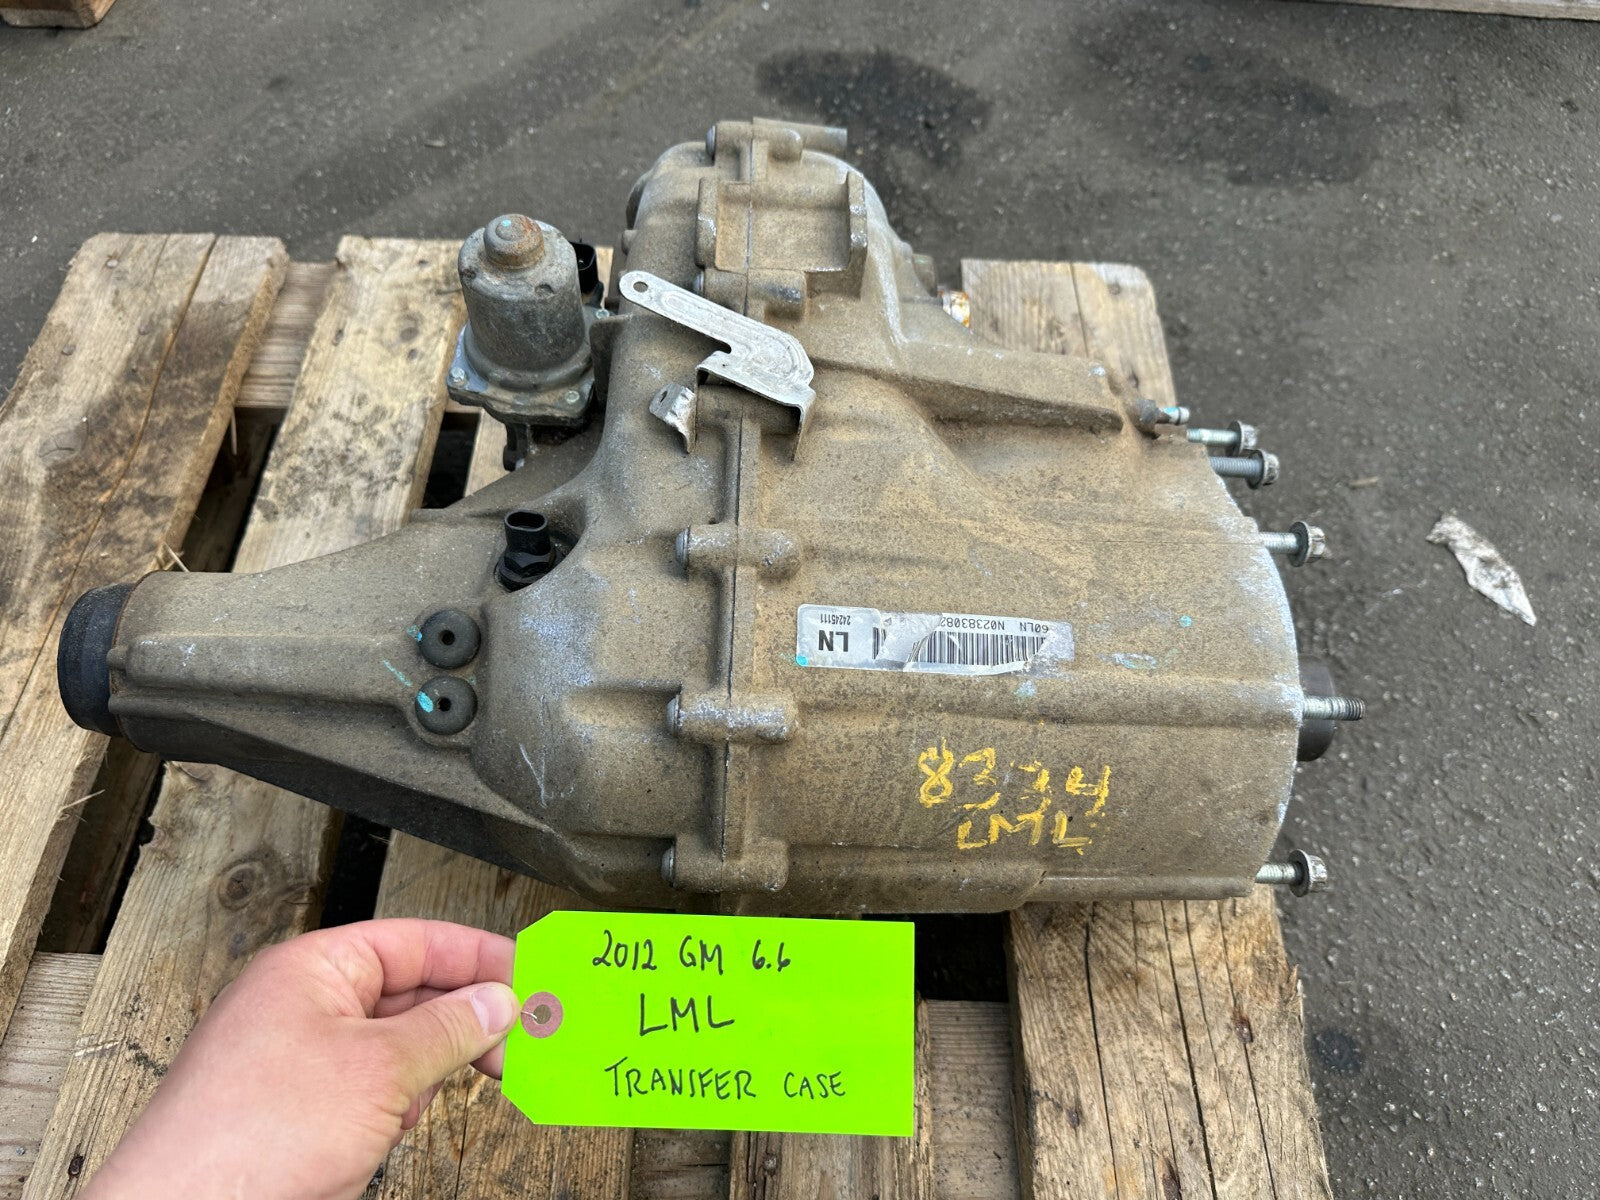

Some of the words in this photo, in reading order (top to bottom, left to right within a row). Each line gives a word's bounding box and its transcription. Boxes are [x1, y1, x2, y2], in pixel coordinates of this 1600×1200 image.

[820, 613, 851, 625] 24245111
[818, 629, 849, 652] LN
[957, 811, 1092, 853] LML
[592, 929, 657, 971] 2012
[679, 935, 723, 975] GM
[752, 939, 791, 972] 6.6
[639, 993, 735, 1036] LML
[605, 1056, 756, 1099] TRANSFER
[784, 1071, 845, 1099] CASE
